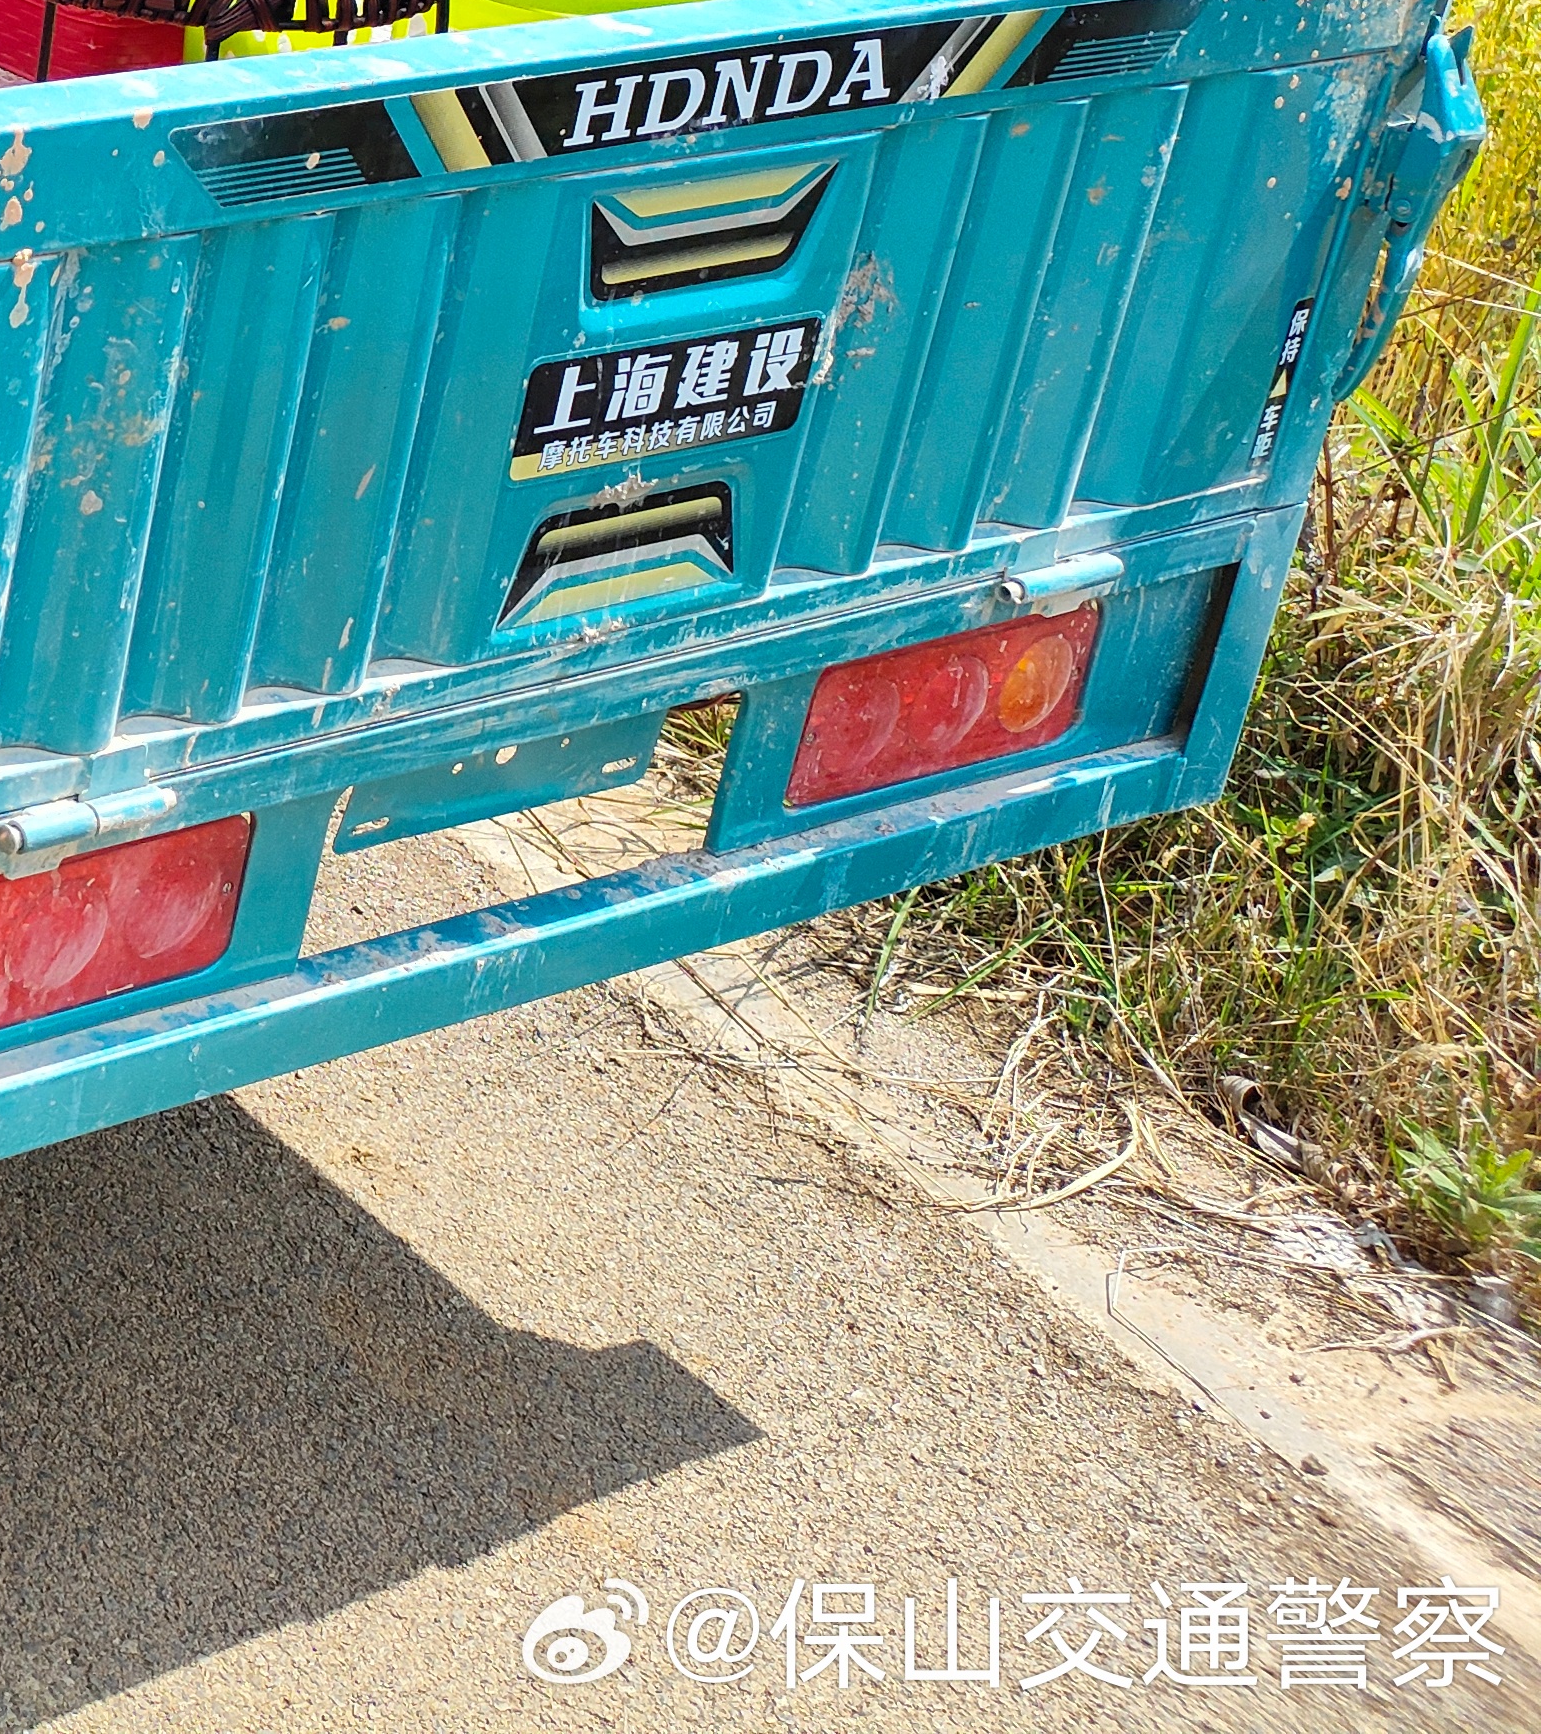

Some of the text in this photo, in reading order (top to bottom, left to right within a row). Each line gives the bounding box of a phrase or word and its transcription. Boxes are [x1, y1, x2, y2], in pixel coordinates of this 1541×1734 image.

[533, 326, 806, 435] 上海建设
[1251, 308, 1311, 458] 保持 车距
[537, 400, 778, 472] 摩托车科技有限公司
